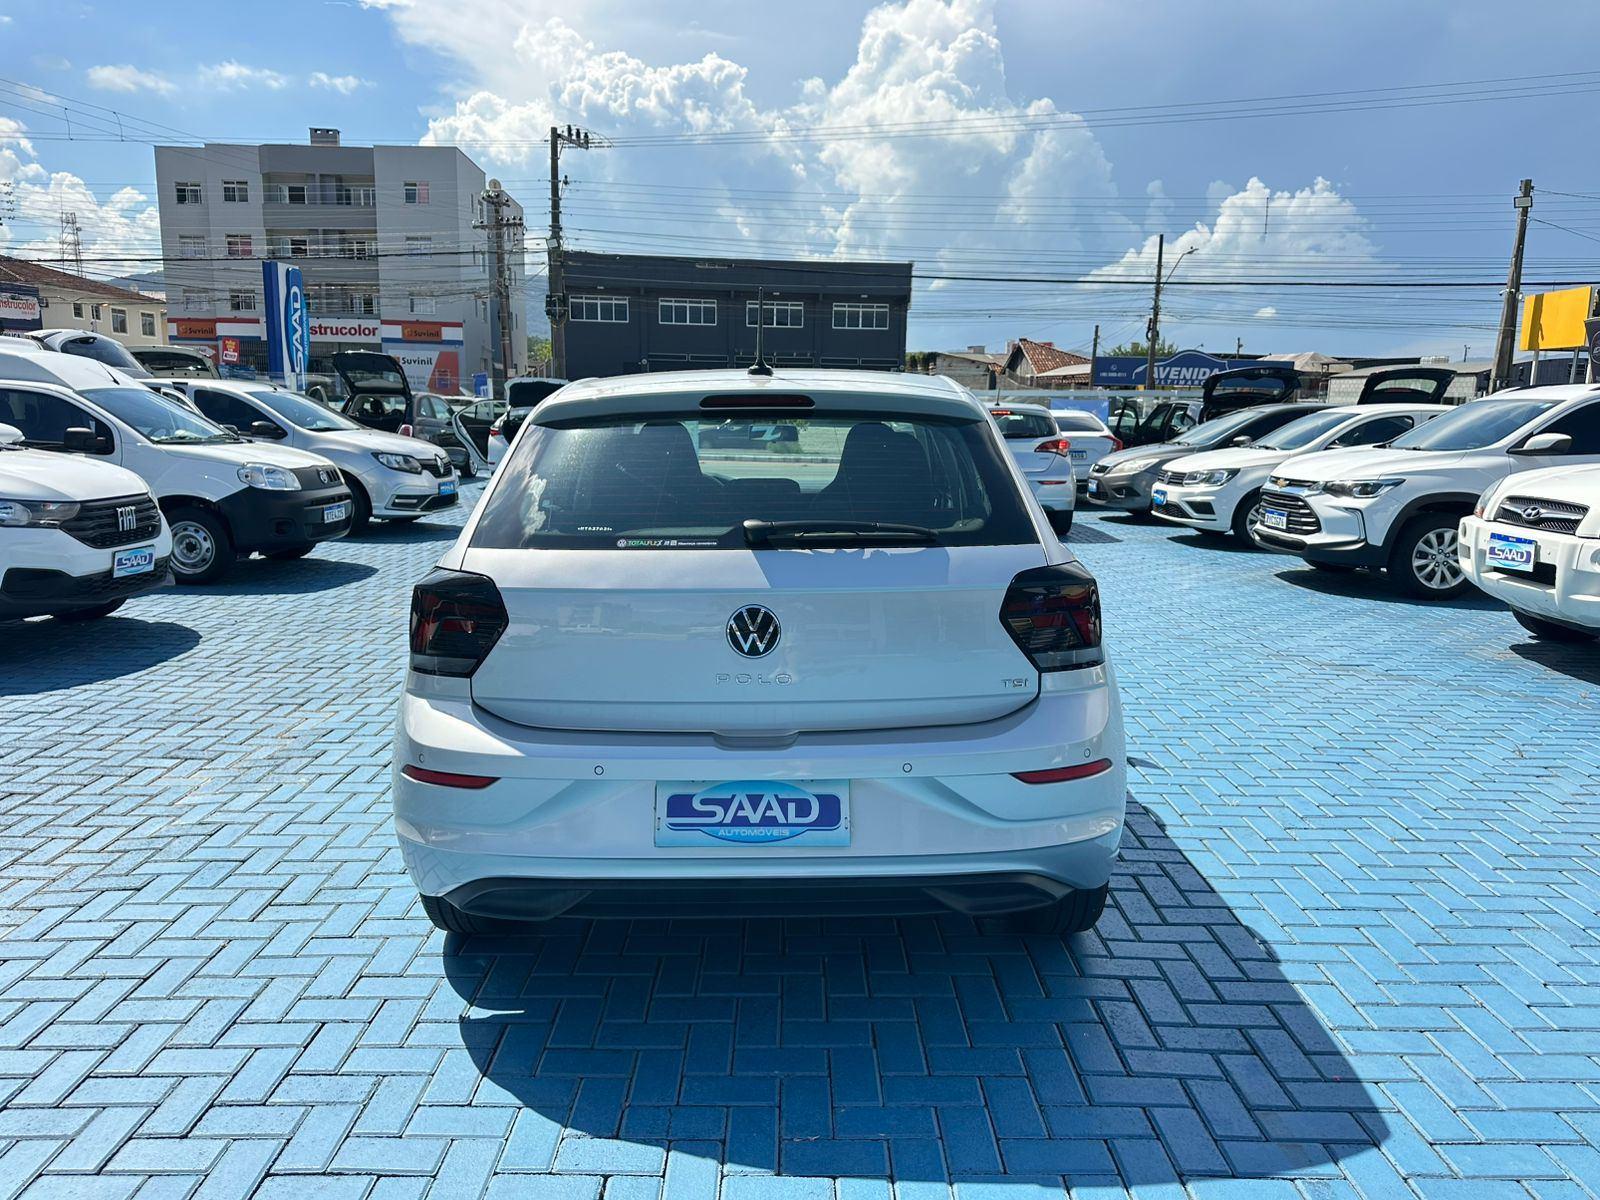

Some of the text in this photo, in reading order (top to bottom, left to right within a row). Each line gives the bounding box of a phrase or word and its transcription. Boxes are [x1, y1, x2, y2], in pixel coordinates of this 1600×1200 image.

[290, 286, 305, 386] SAAD
[414, 330, 439, 338] Suvinil
[402, 357, 433, 366] Suvinil
[116, 506, 136, 531] FIAT
[122, 553, 149, 567] SAAD
[1495, 546, 1526, 562] SAAD
[715, 673, 793, 685] POLO
[1001, 678, 1029, 688] TSI
[688, 793, 820, 825] SAAD
[717, 827, 790, 837] AUTOMÓVEIS
